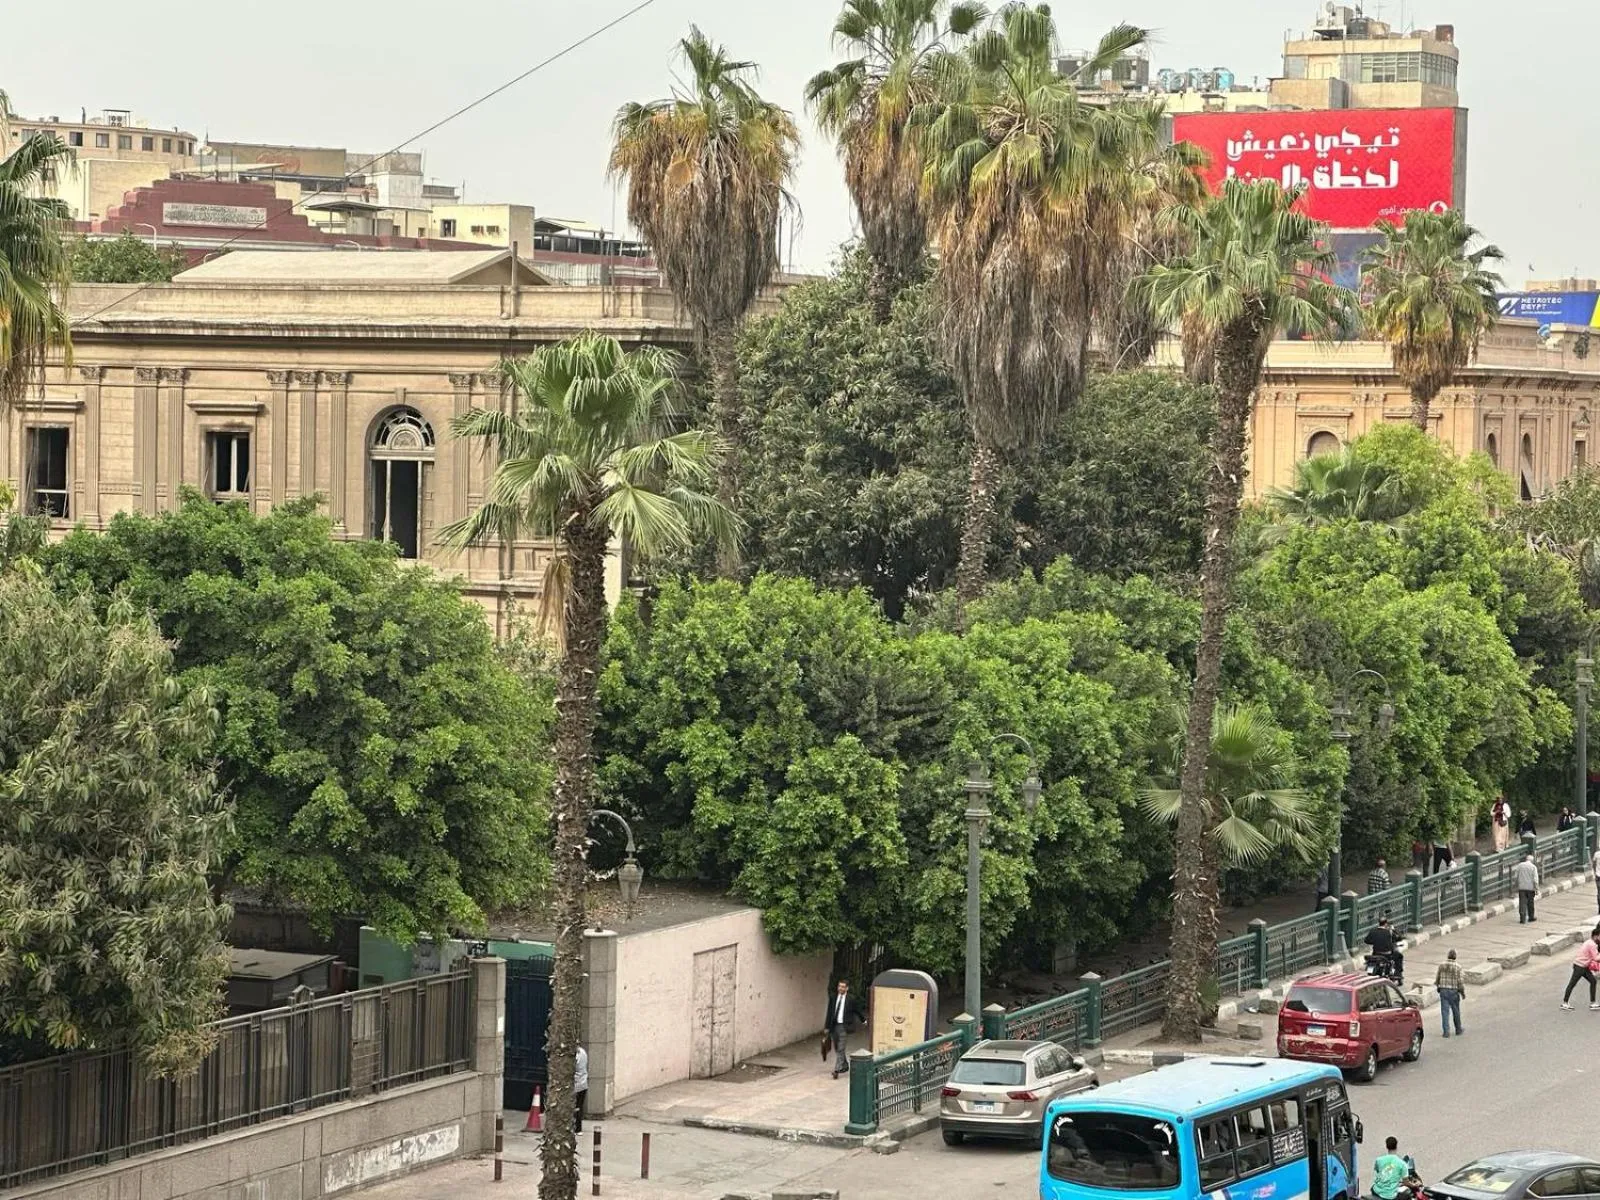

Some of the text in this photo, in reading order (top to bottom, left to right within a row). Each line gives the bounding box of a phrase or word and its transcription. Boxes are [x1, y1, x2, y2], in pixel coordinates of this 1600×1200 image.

[1226, 125, 1400, 162] تيجي نعيش
[1312, 157, 1399, 190] لحظة
